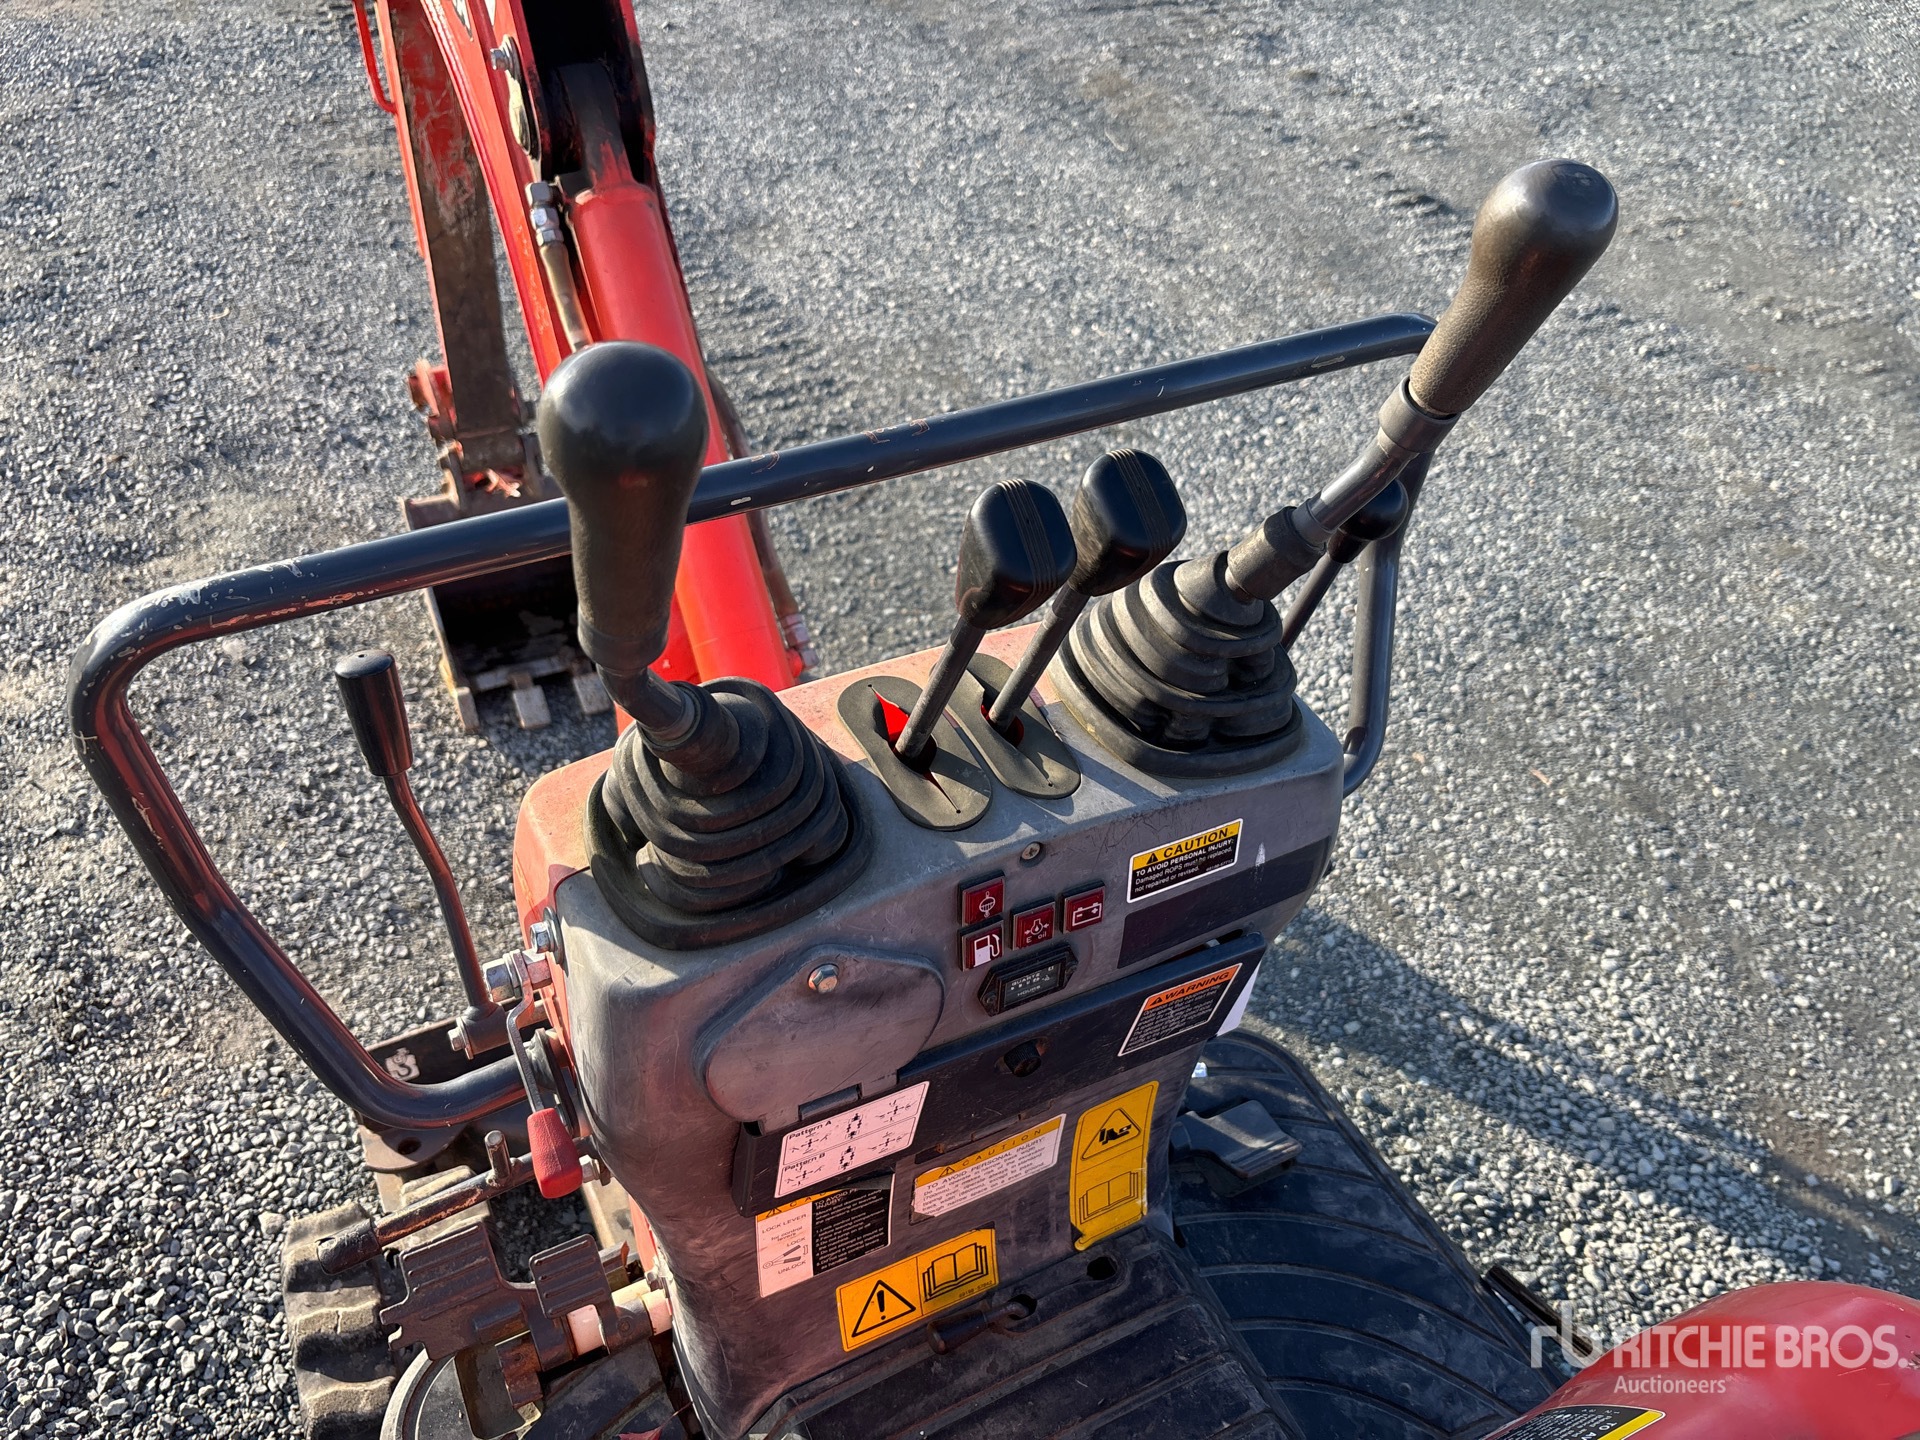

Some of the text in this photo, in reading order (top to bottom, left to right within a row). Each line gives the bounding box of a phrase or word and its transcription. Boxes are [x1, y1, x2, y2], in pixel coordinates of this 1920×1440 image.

[1163, 828, 1227, 858] CAUTION
[1135, 846, 1232, 885] Damaged ROPS must be replaced.
[1136, 837, 1233, 876] TO AVOID PERSONAL INJURY:
[1134, 884, 1144, 893] not
[1145, 876, 1169, 889] repaired
[1170, 873, 1176, 881] or
[1038, 932, 1046, 940] oil
[1163, 970, 1230, 1000] WARNING
[788, 1124, 824, 1140] Pattern
[962, 1128, 1041, 1166] CAUTION
[784, 1156, 817, 1172] Pattern
[927, 1181, 938, 1190] TO
[942, 1169, 967, 1184] AVOID
[970, 1150, 1012, 1172] PERSONAL
[761, 1212, 806, 1234] LOCK LEVER
[786, 1236, 805, 1247] LOCK
[778, 1259, 806, 1274] UNLOCK
